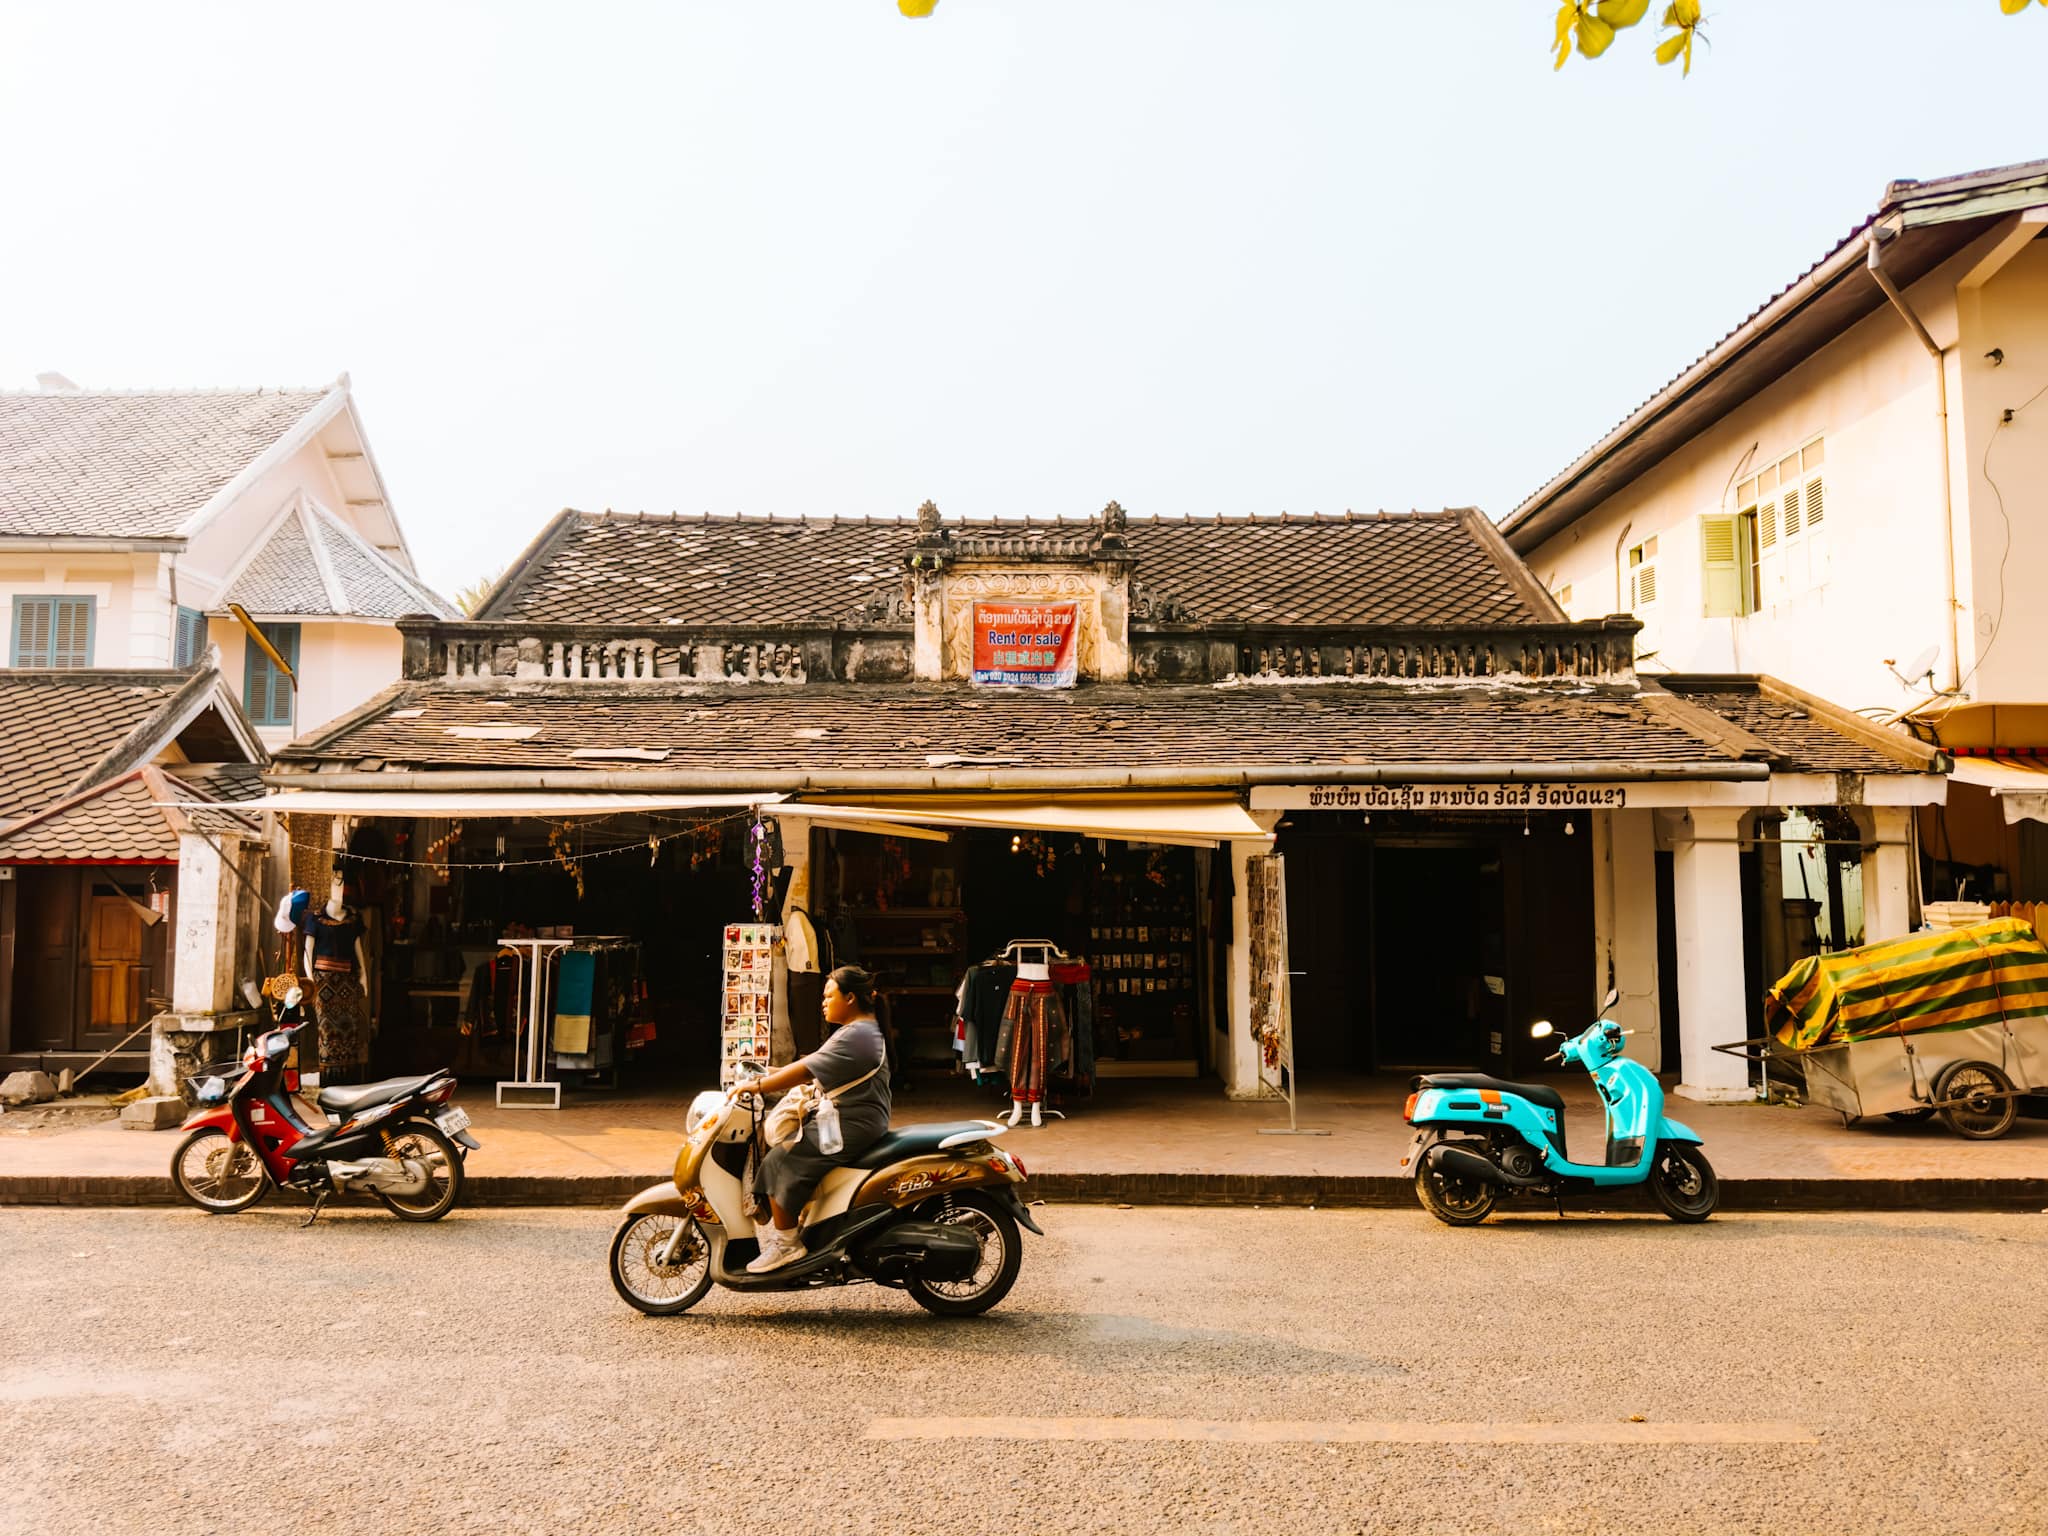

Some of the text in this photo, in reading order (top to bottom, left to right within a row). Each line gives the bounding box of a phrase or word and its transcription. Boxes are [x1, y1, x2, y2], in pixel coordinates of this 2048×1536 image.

[989, 631, 1061, 645] Rent or sale
[1429, 783, 1489, 805] ນາມບັດ
